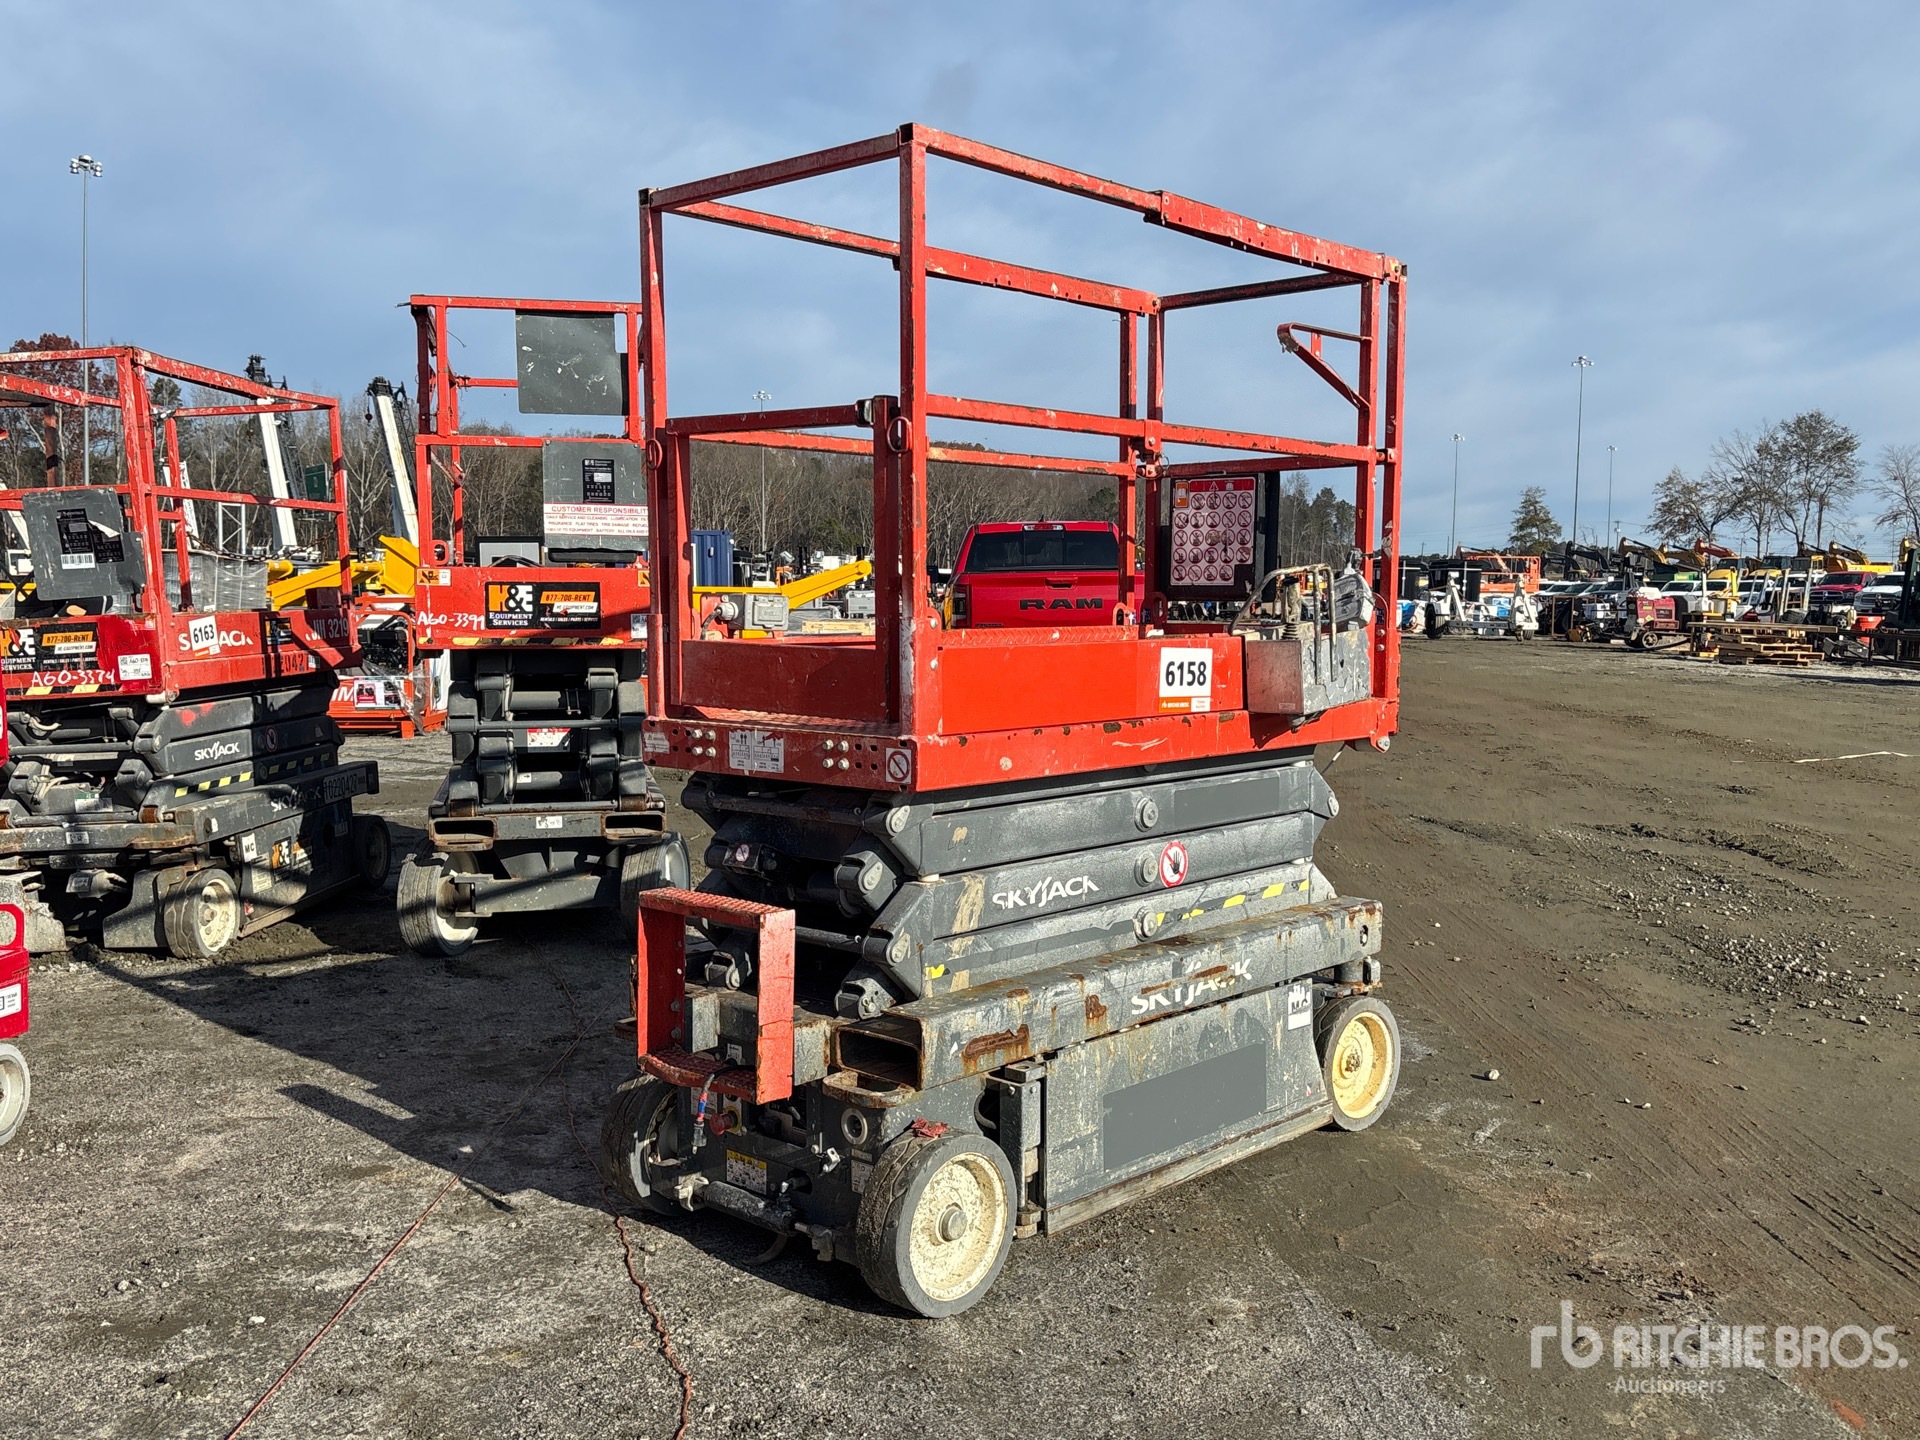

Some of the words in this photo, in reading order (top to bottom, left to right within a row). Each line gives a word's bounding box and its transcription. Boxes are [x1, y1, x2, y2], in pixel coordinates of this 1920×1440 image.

[551, 506, 592, 514] CUSTOMER
[593, 506, 648, 515] RESPONSIBILIT
[488, 585, 534, 612] H&E
[545, 594, 592, 602] 877-700-RENT
[1019, 598, 1103, 610] RAM
[192, 624, 215, 643] 6163
[327, 617, 349, 638] 3219
[178, 630, 253, 651] SACK
[31, 668, 115, 688] A60-3374
[1165, 661, 1207, 687] 6158
[194, 741, 240, 761] SKYJACK
[992, 875, 1100, 910] SKYJACK
